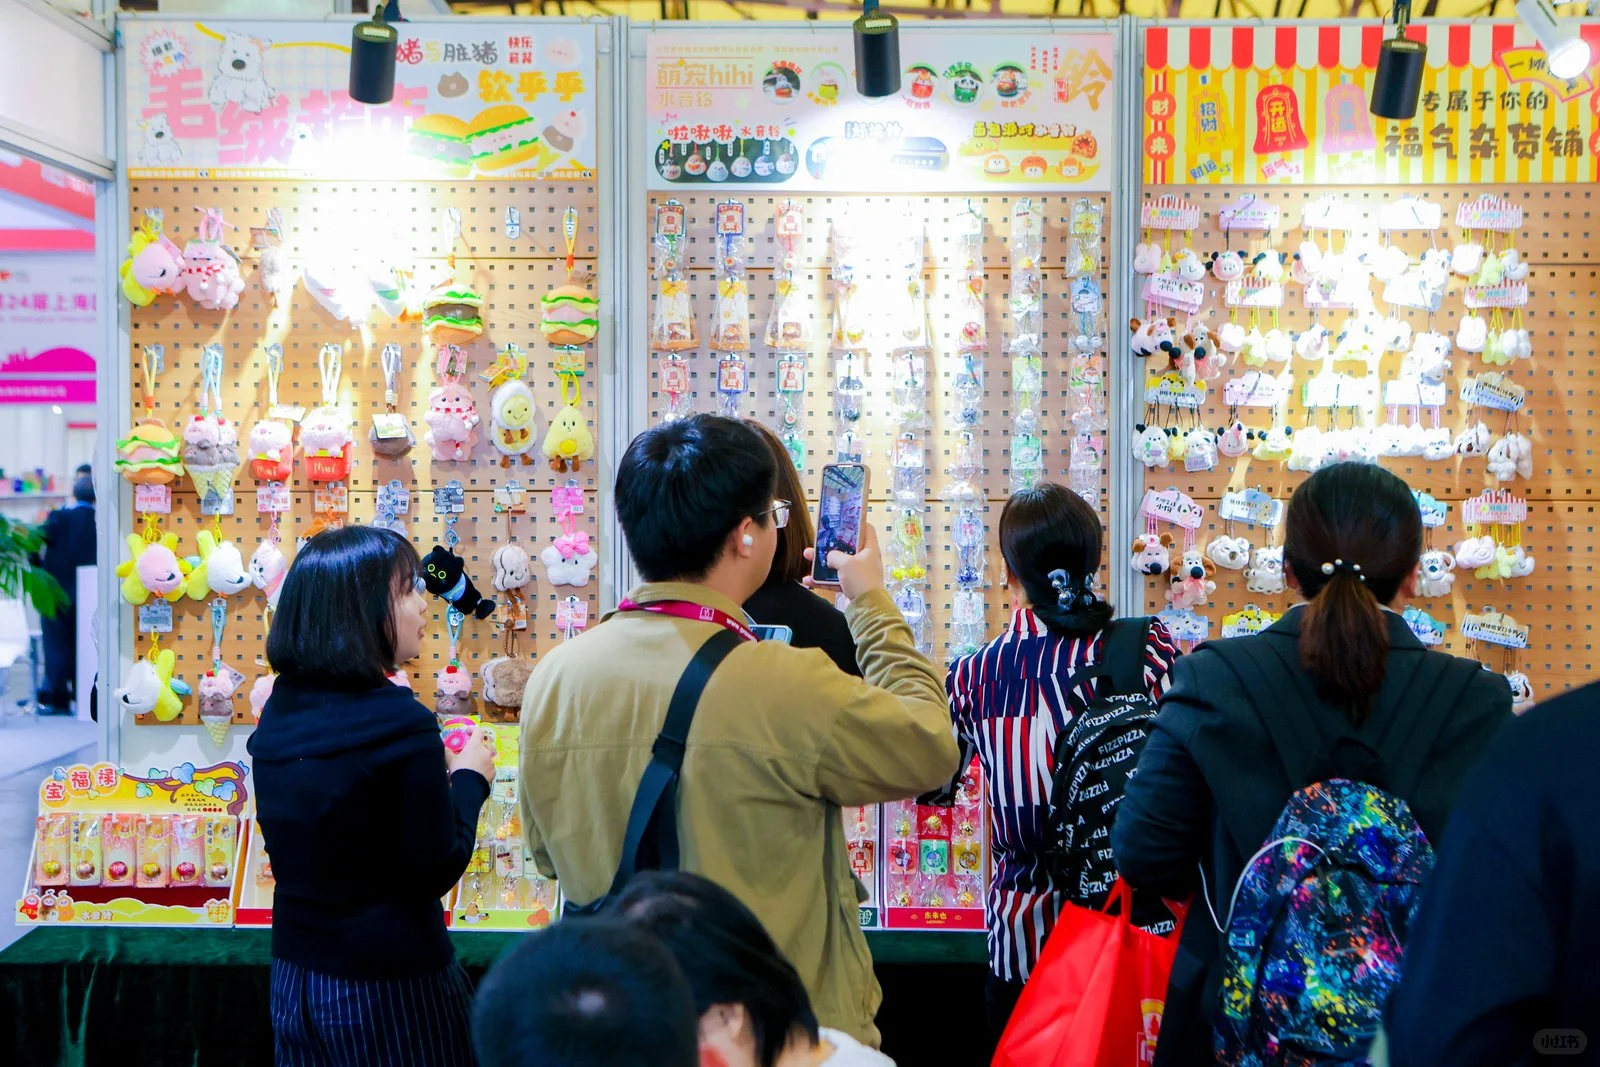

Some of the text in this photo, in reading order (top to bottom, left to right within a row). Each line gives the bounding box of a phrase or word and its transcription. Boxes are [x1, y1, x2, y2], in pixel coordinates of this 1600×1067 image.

[477, 69, 586, 103] 软乎乎
[1421, 89, 1549, 112] 专属于你的
[1200, 102, 1217, 132] 招财
[1269, 101, 1286, 132] 开运
[1384, 123, 1584, 160] 福气杂货铺
[0, 292, 96, 313] 24届上海
[1085, 704, 1135, 728] FIZZPIZZA
[1098, 729, 1147, 755] FIZZPIZZA
[46, 768, 117, 800] 宝福禄
